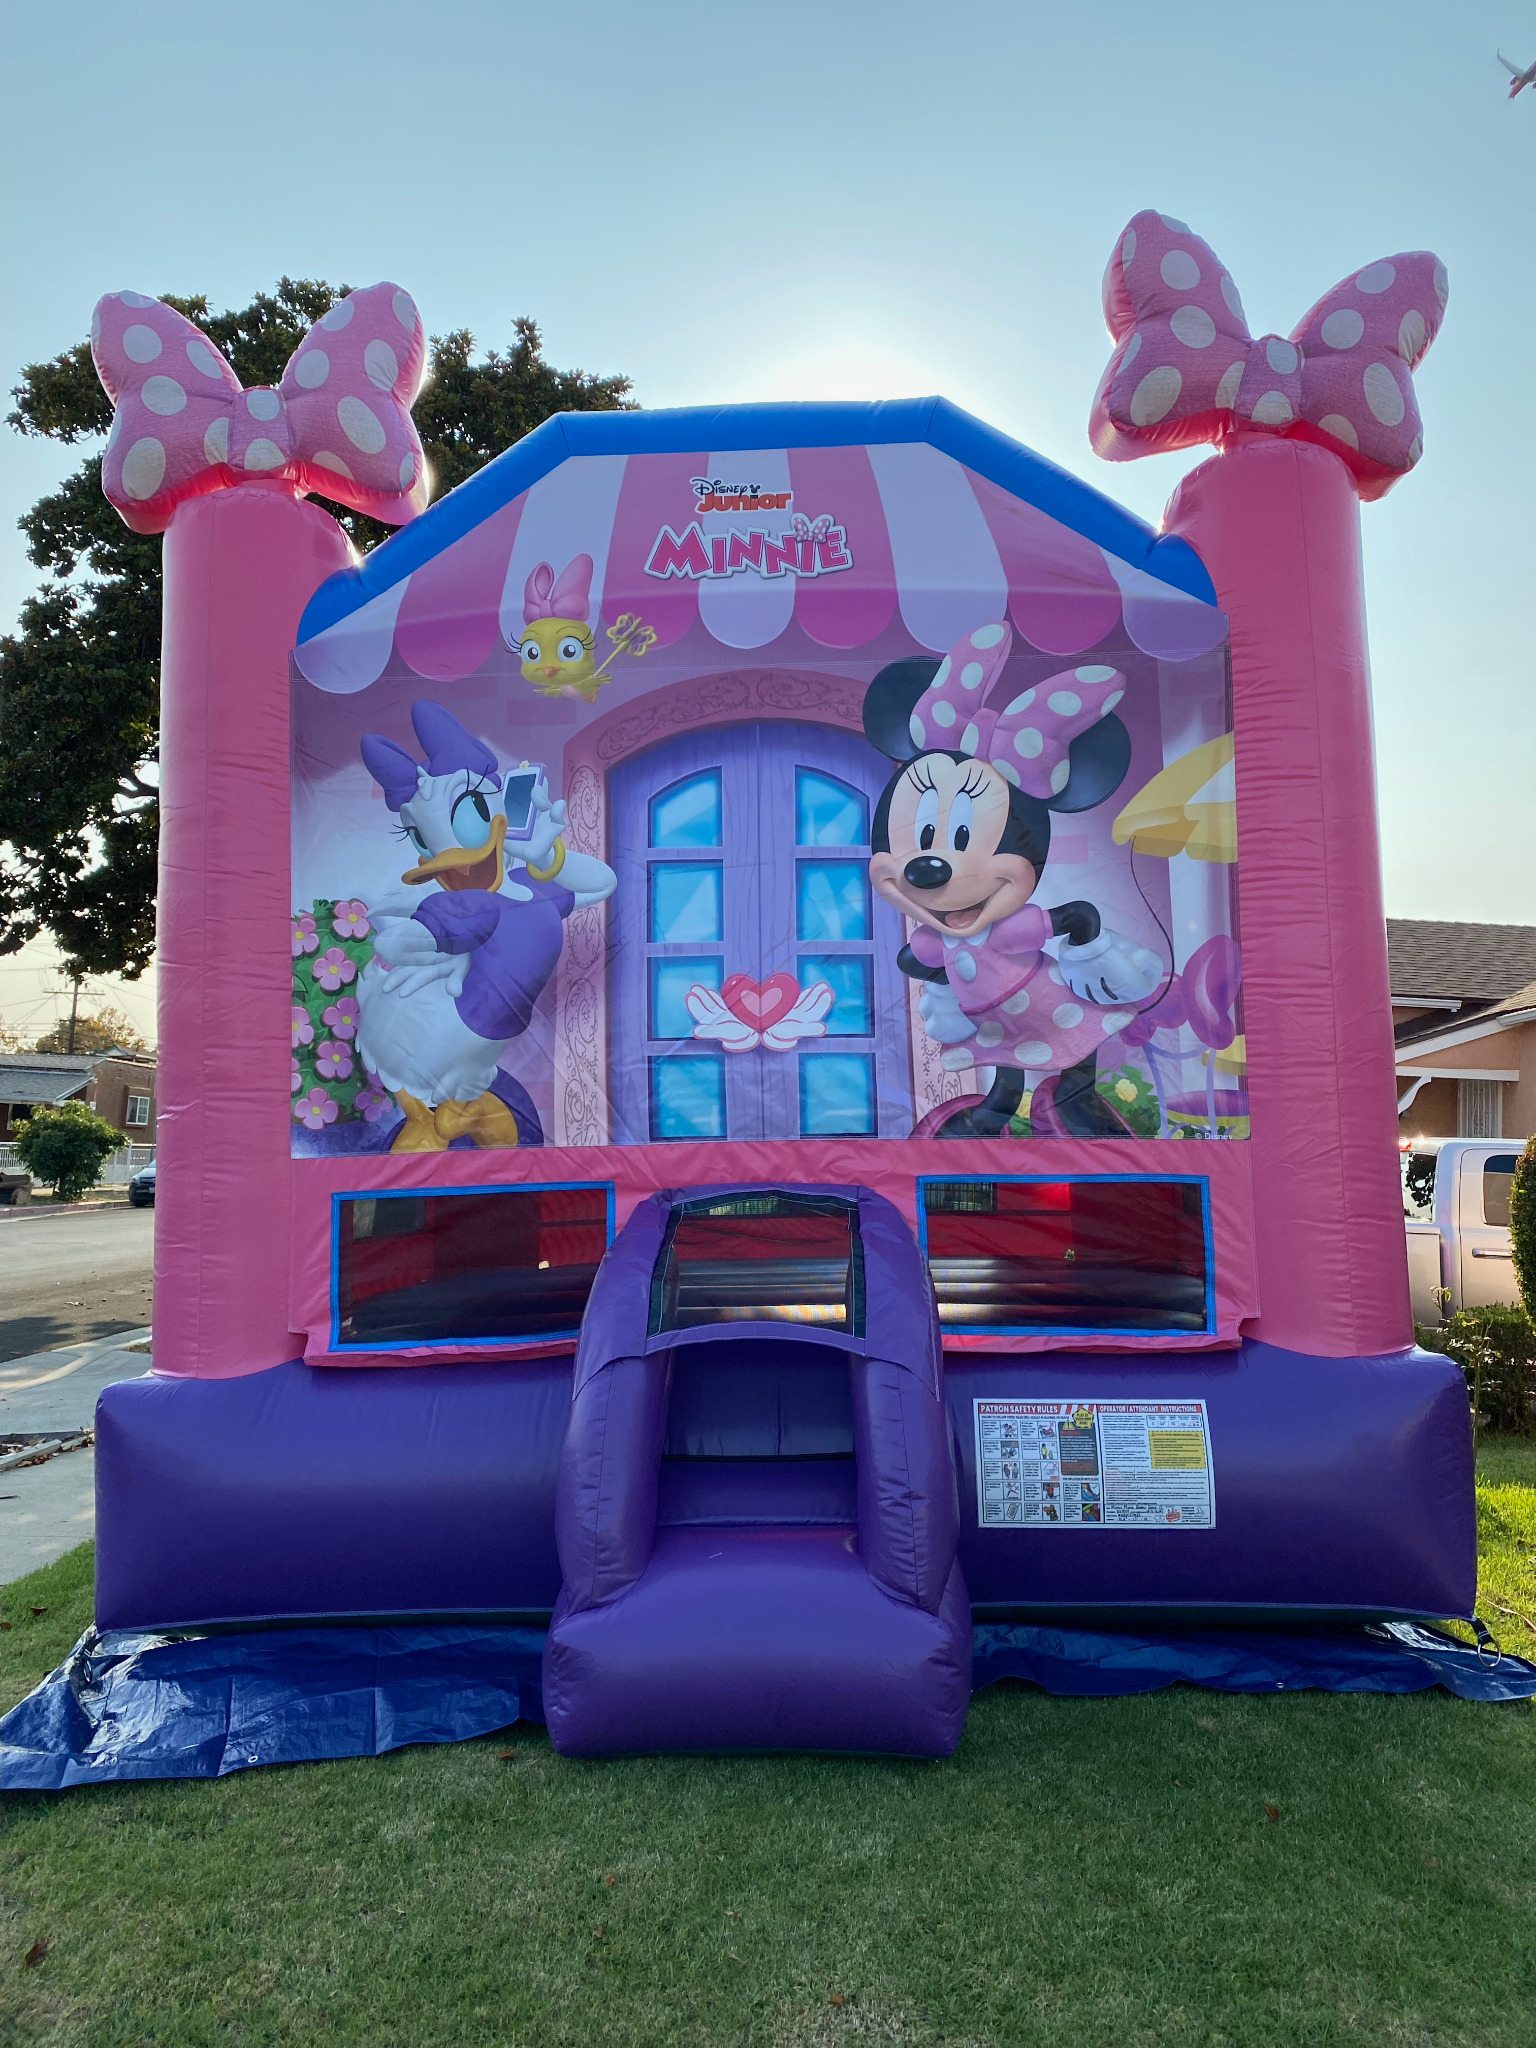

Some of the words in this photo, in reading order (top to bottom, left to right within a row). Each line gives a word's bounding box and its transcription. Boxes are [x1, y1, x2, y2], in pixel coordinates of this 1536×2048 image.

[647, 525, 850, 576] MINNIE
[980, 1405, 1009, 1413] PATRON
[1010, 1405, 1037, 1413] SAFETY
[1037, 1405, 1058, 1413] RULES
[1099, 1404, 1126, 1412] OPERATOR
[1129, 1404, 1159, 1412] ATTENDANT
[1160, 1404, 1197, 1412] INSTRUCTIONS
